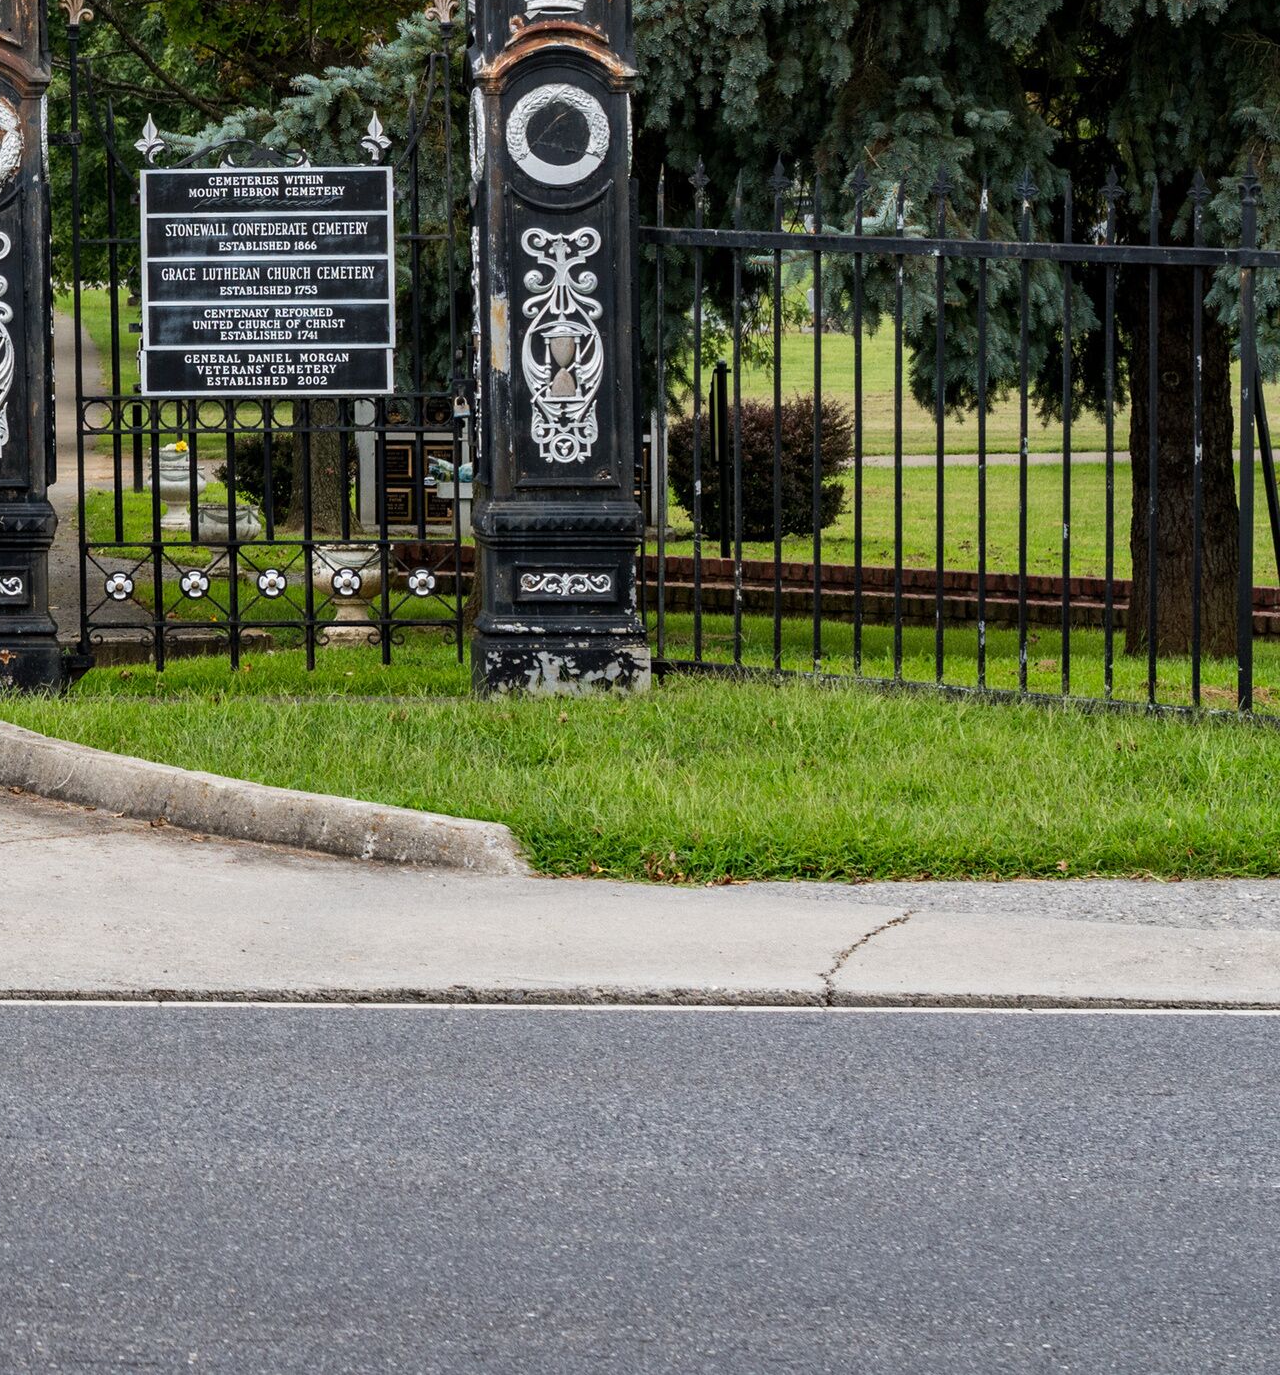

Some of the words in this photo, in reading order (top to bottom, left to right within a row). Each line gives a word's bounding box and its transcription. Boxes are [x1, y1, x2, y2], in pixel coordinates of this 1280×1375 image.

[209, 176, 278, 185] CEMETERIES
[285, 176, 323, 184] WITHIN
[189, 188, 228, 198] MOUNT
[234, 187, 279, 197] HEBRON
[285, 186, 345, 196] CEMETERY
[165, 224, 228, 236] STONEWALL
[233, 223, 307, 236] CONFEDERATE
[313, 222, 368, 235] CEMETERY
[219, 242, 290, 251] ESTABLISHED
[294, 241, 317, 250] 1866
[161, 268, 196, 281] GRACE
[203, 268, 260, 280] LUTHERAN
[267, 267, 310, 280] CHURCH
[317, 266, 375, 279] CEMETERY
[220, 286, 291, 295] ESTABLISHED
[295, 286, 317, 295] 1753
[204, 309, 269, 318] CENTENARY
[275, 308, 333, 317] REFORMED
[193, 320, 233, 330] UNITED
[238, 320, 280, 329] CHURCH
[286, 320, 300, 328] OF
[306, 319, 345, 328] CHRIST
[221, 331, 292, 340] ESTABLISHED
[298, 331, 318, 340] 1741
[184, 354, 240, 363] GENERAL
[248, 354, 292, 363] DANIEL
[300, 353, 349, 362] MORGAN
[197, 365, 264, 374] VETERANS'
[270, 365, 336, 374] CEMETERY
[207, 377, 288, 386] ESTABLISHED
[297, 377, 328, 385] 2002
